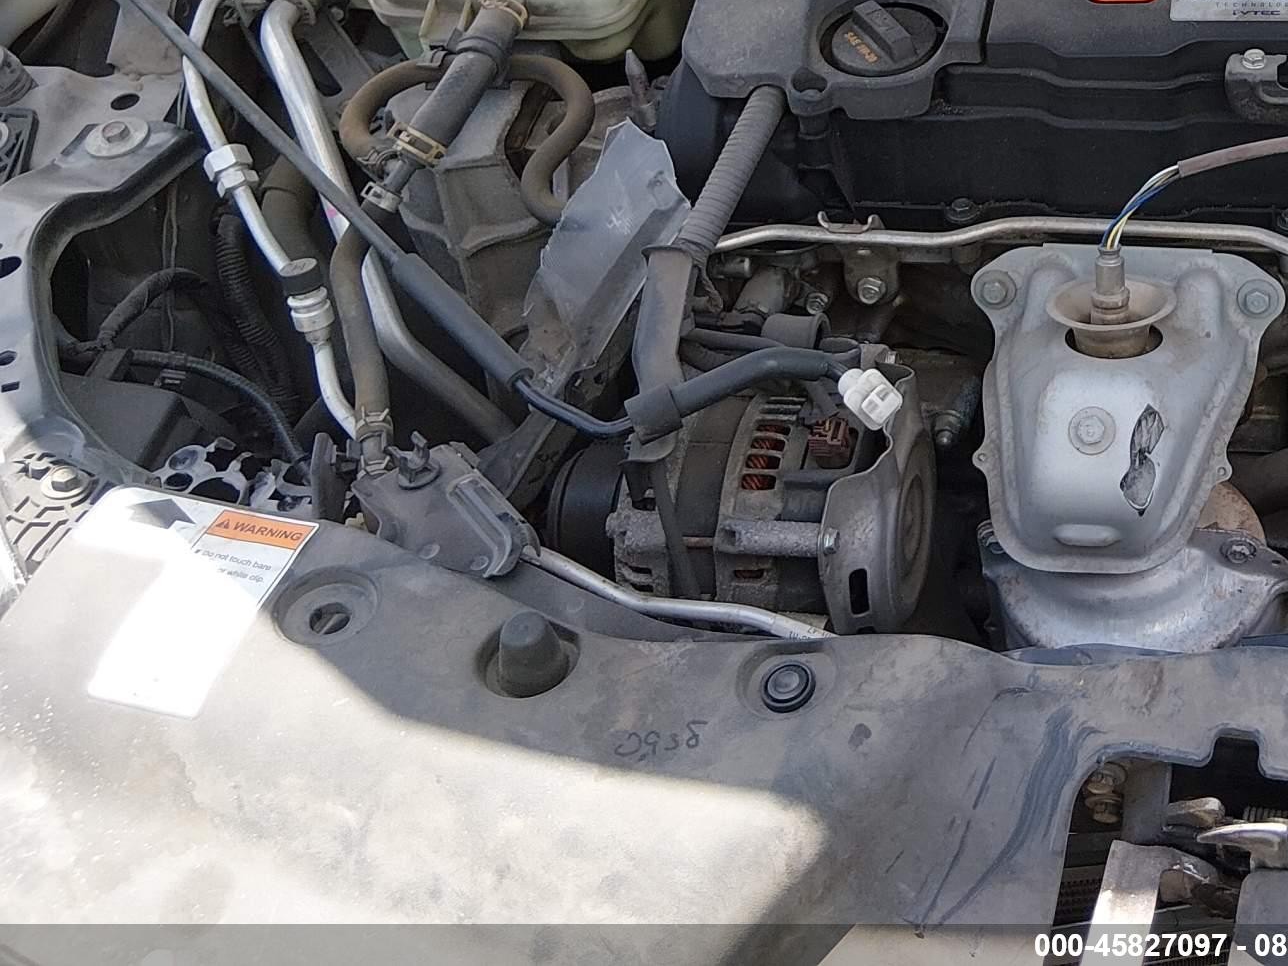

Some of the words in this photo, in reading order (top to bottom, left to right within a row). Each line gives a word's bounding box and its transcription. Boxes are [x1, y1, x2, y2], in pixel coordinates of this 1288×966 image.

[232, 520, 303, 542] WARNING
[201, 550, 214, 558] Do
[214, 552, 229, 561] not
[229, 555, 252, 567] touch
[252, 561, 272, 571] bare
[227, 570, 249, 579] white
